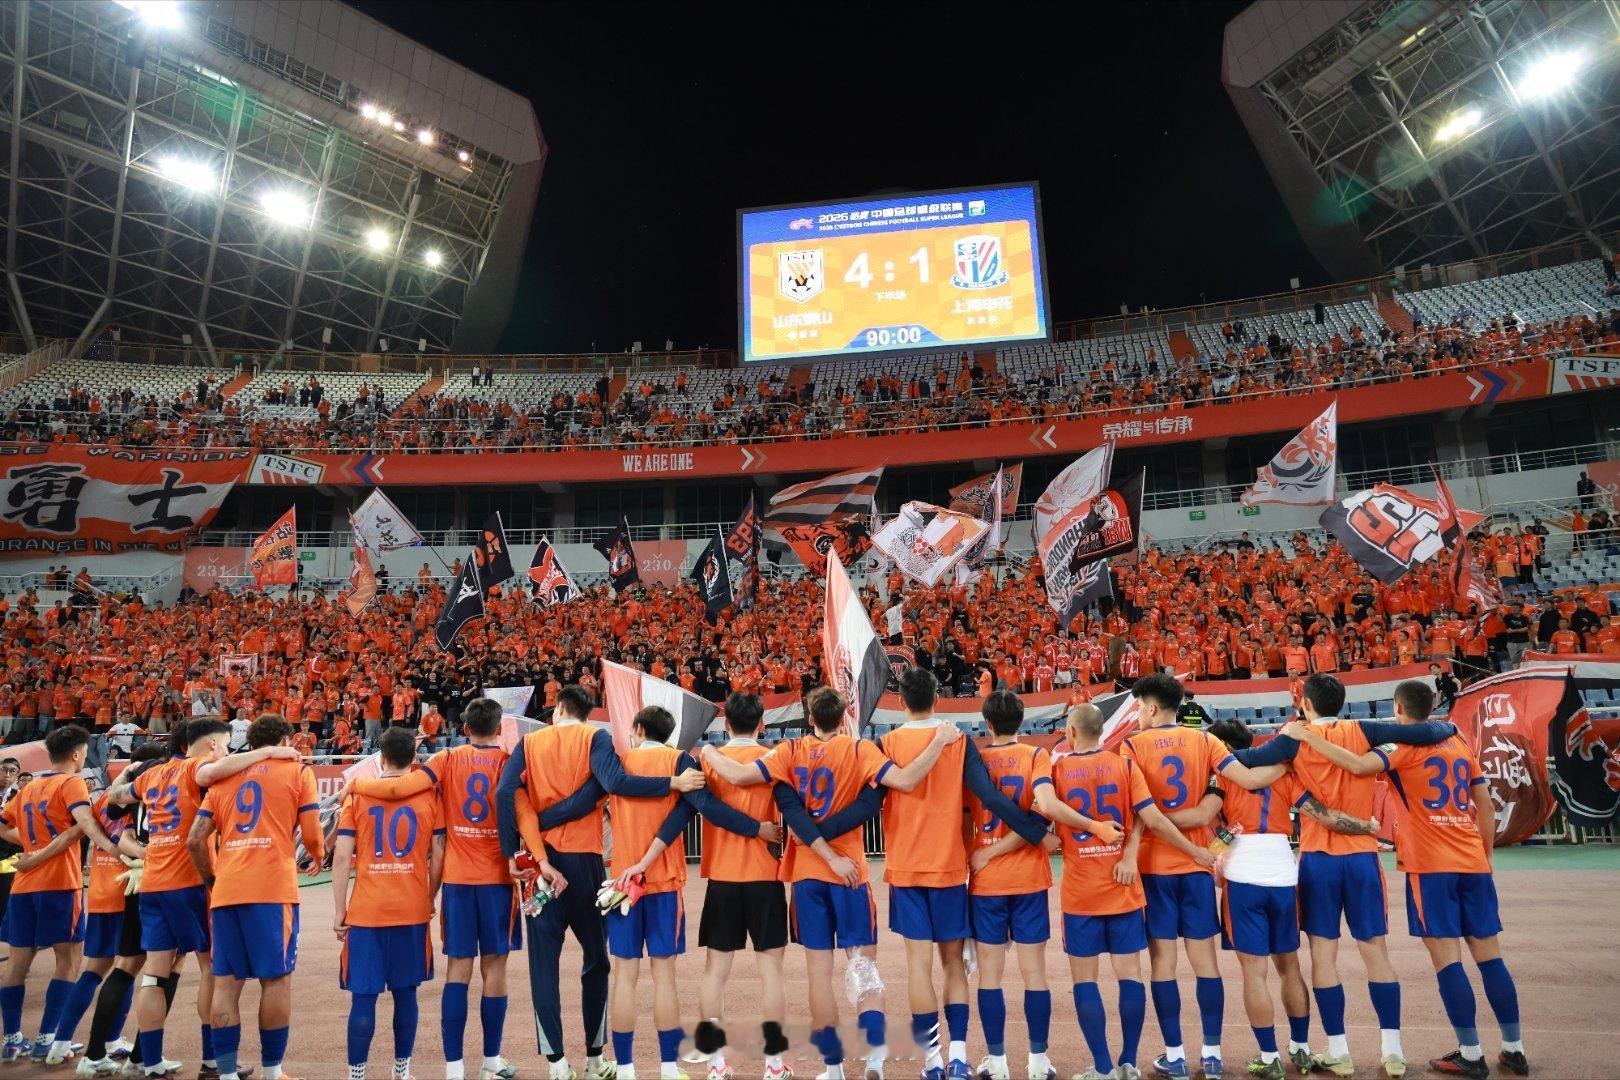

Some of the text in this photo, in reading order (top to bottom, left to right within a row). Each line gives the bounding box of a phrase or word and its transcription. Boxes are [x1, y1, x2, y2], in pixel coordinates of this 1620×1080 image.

[843, 252, 874, 289] 4
[909, 246, 930, 284] 1
[866, 327, 922, 347] 90:00
[1102, 415, 1194, 440] 荣耀与传承
[263, 455, 316, 478] TSFC
[623, 452, 694, 473] WE ARE ONE
[462, 772, 490, 823] 8
[795, 766, 835, 817] 19
[1160, 755, 1188, 809] 3
[1423, 756, 1471, 812] 38
[23, 800, 58, 845] 11
[236, 780, 263, 834] 9
[368, 805, 418, 858] 10
